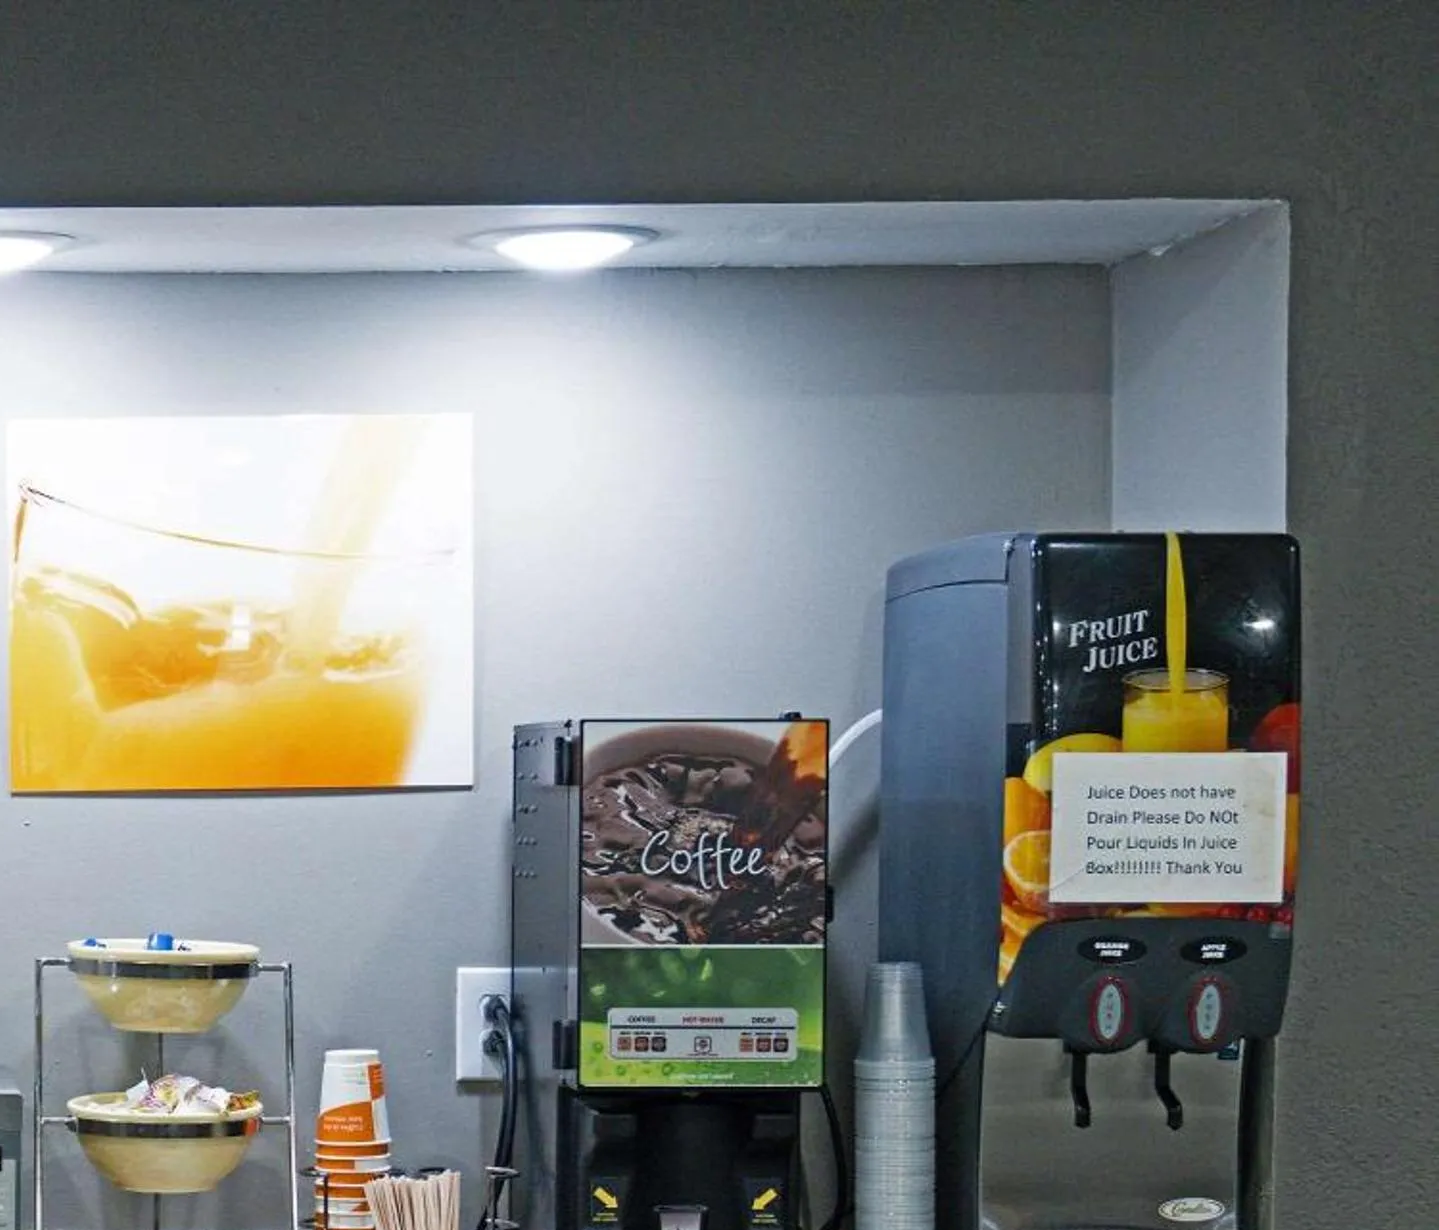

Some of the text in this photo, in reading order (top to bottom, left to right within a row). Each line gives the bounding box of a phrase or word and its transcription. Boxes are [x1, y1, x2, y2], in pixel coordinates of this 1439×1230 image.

[1069, 609, 1149, 648] FRUIT
[1082, 637, 1158, 672] JUICE
[1087, 785, 1237, 800] Juice Does not have
[1087, 810, 1239, 825] Drain Please Do NOt
[1087, 835, 1237, 852] Pour Liquids In Juice
[641, 830, 767, 890] Coffee
[1166, 860, 1210, 875] Thank
[1213, 860, 1243, 875] You
